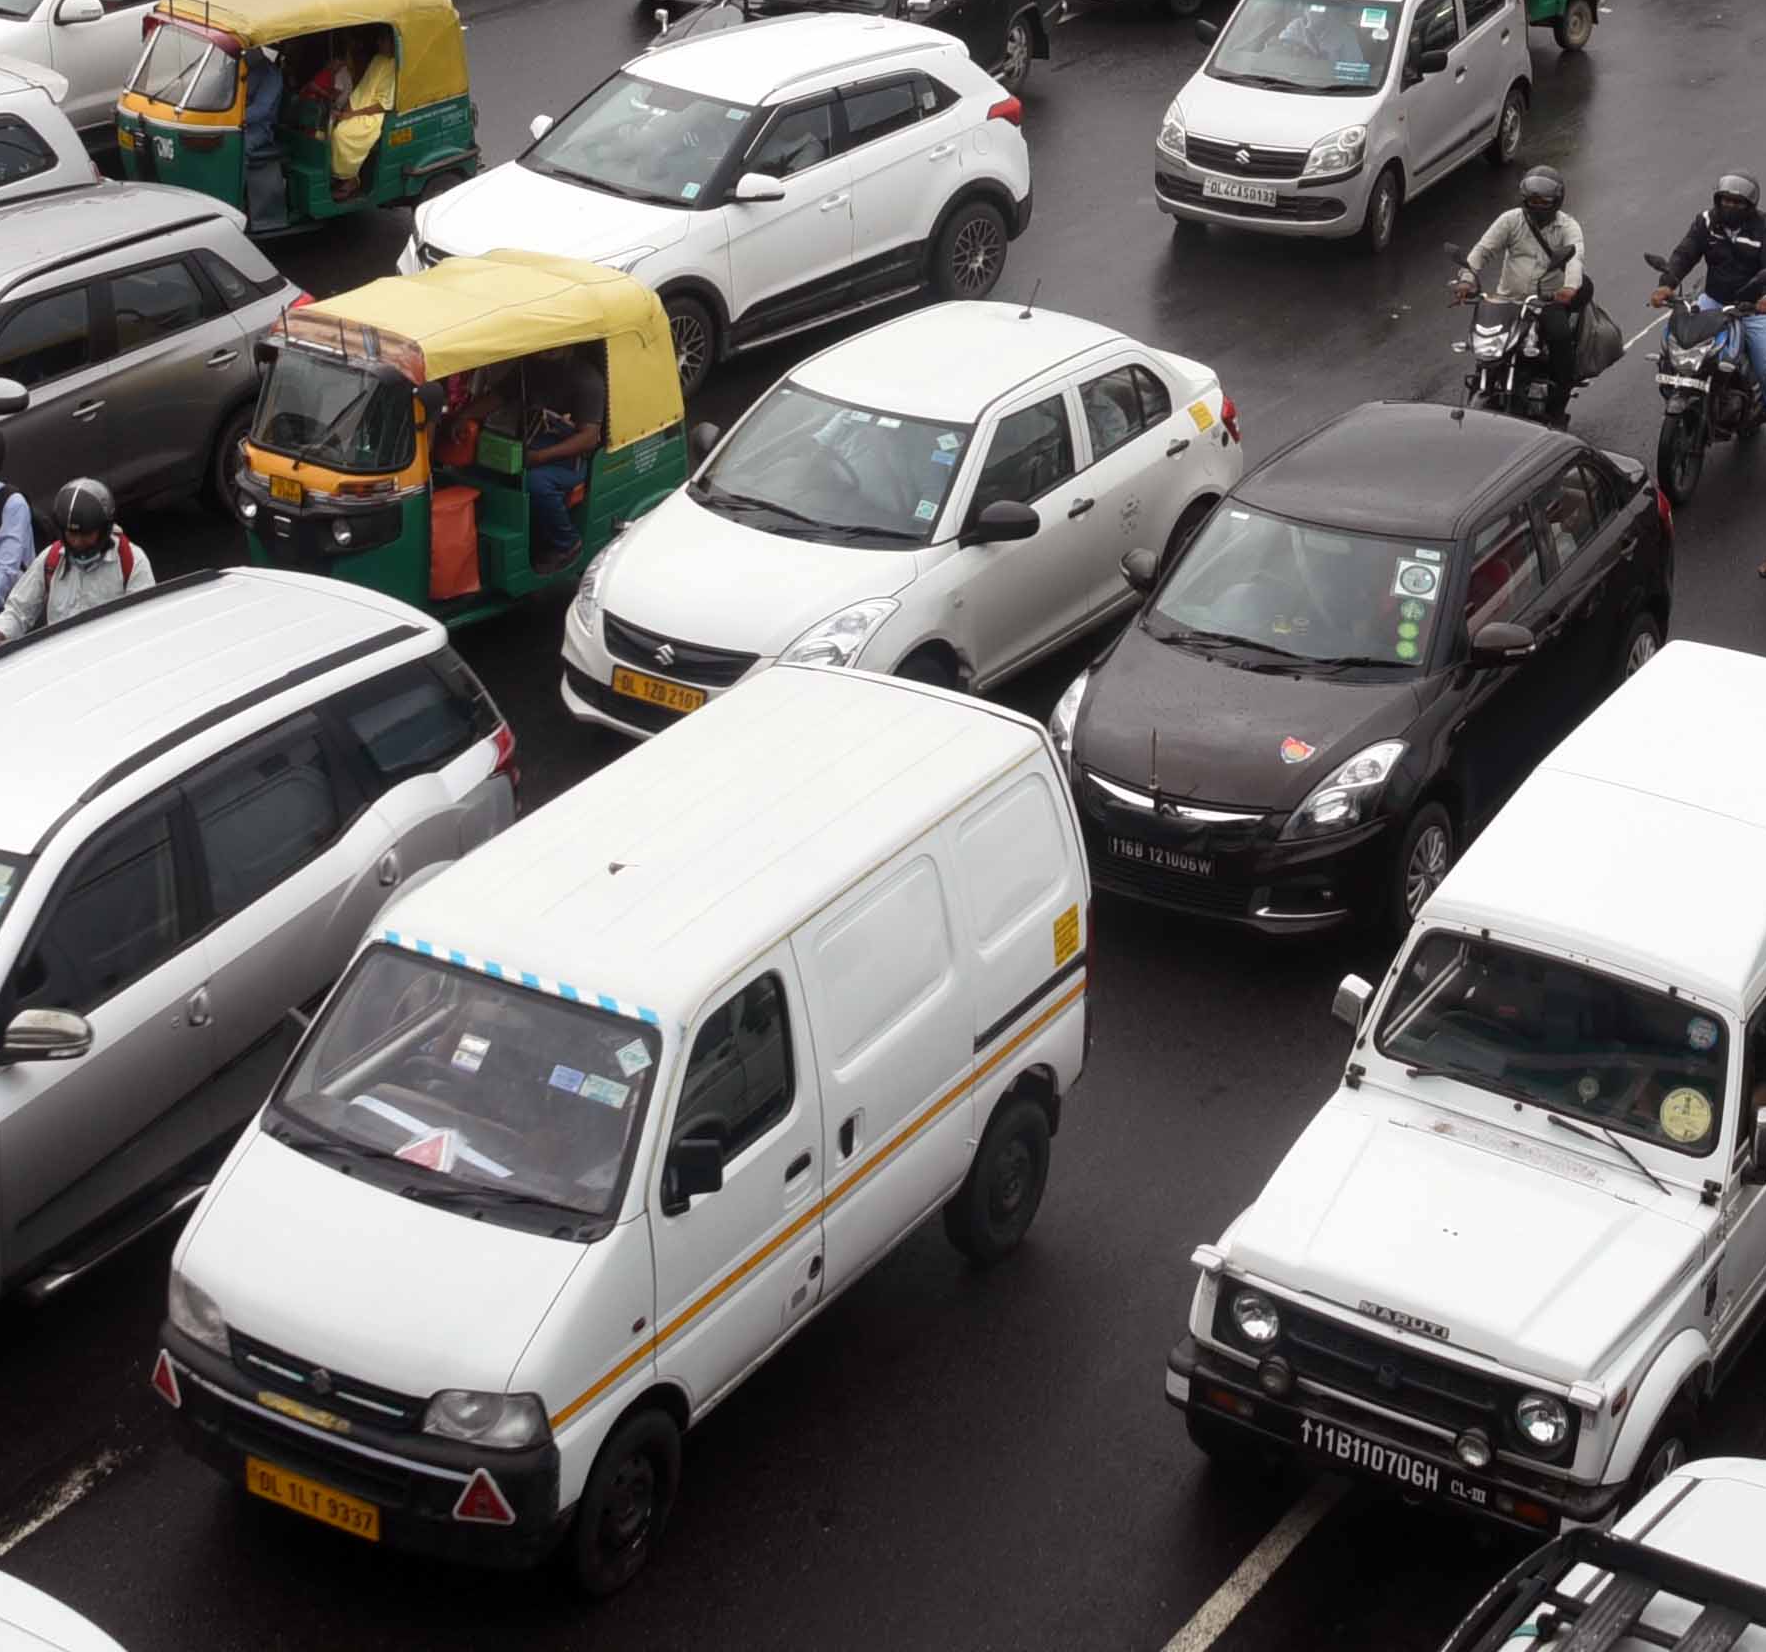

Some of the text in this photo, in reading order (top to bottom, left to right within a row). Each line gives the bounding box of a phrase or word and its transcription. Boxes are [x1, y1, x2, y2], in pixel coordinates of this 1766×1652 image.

[621, 674, 636, 692] DL
[1359, 1299, 1450, 1340] MARUTI
[258, 1465, 282, 1498] DL
[326, 1495, 374, 1533] 9337
[1449, 1479, 1487, 1504] CL-III
